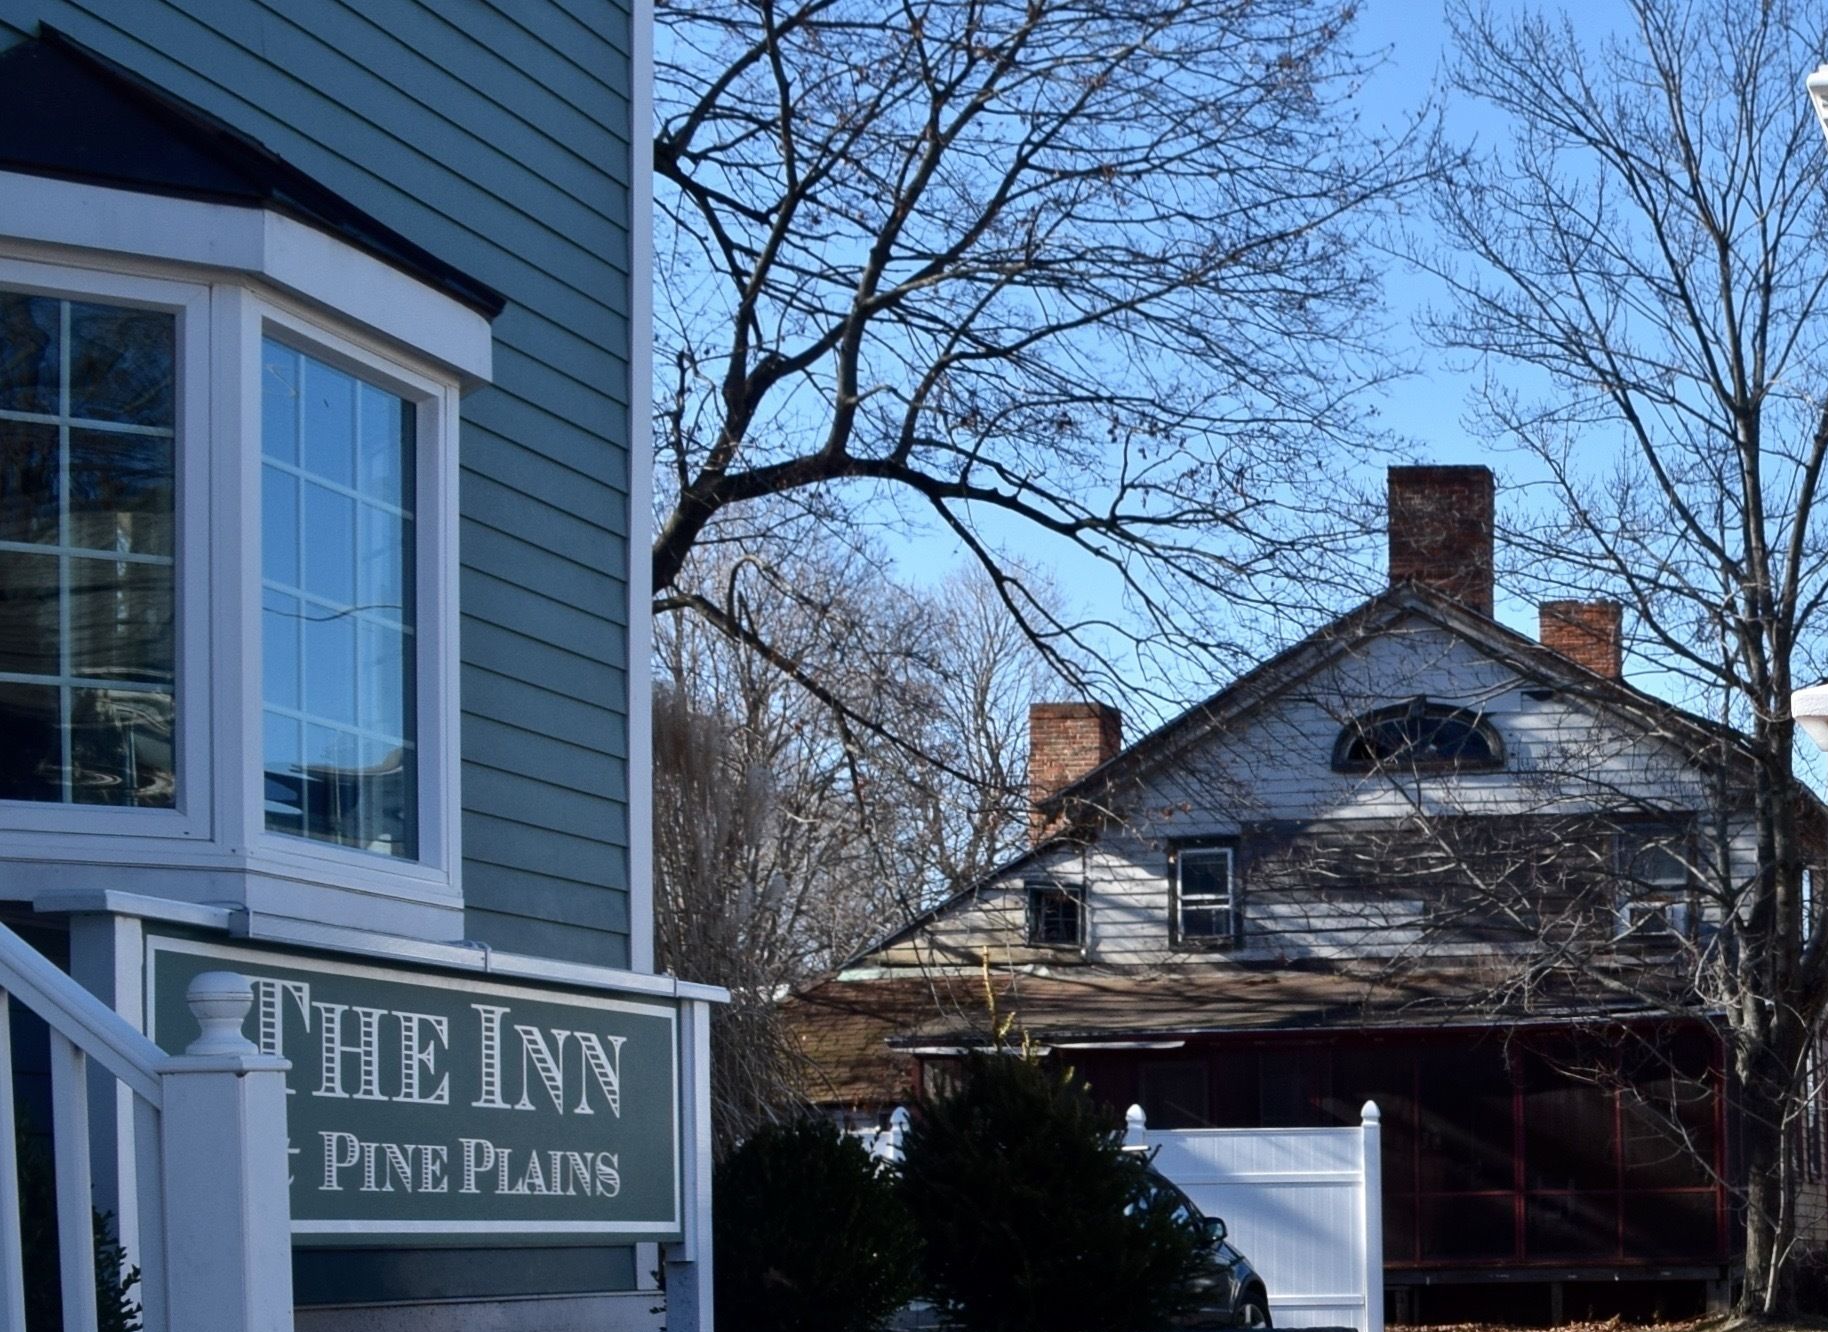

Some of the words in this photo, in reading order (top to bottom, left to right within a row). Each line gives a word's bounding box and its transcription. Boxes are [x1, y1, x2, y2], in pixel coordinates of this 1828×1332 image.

[471, 1004, 627, 1118] INN
[318, 1131, 448, 1193] PINE
[459, 1138, 621, 1198] PLAINS
